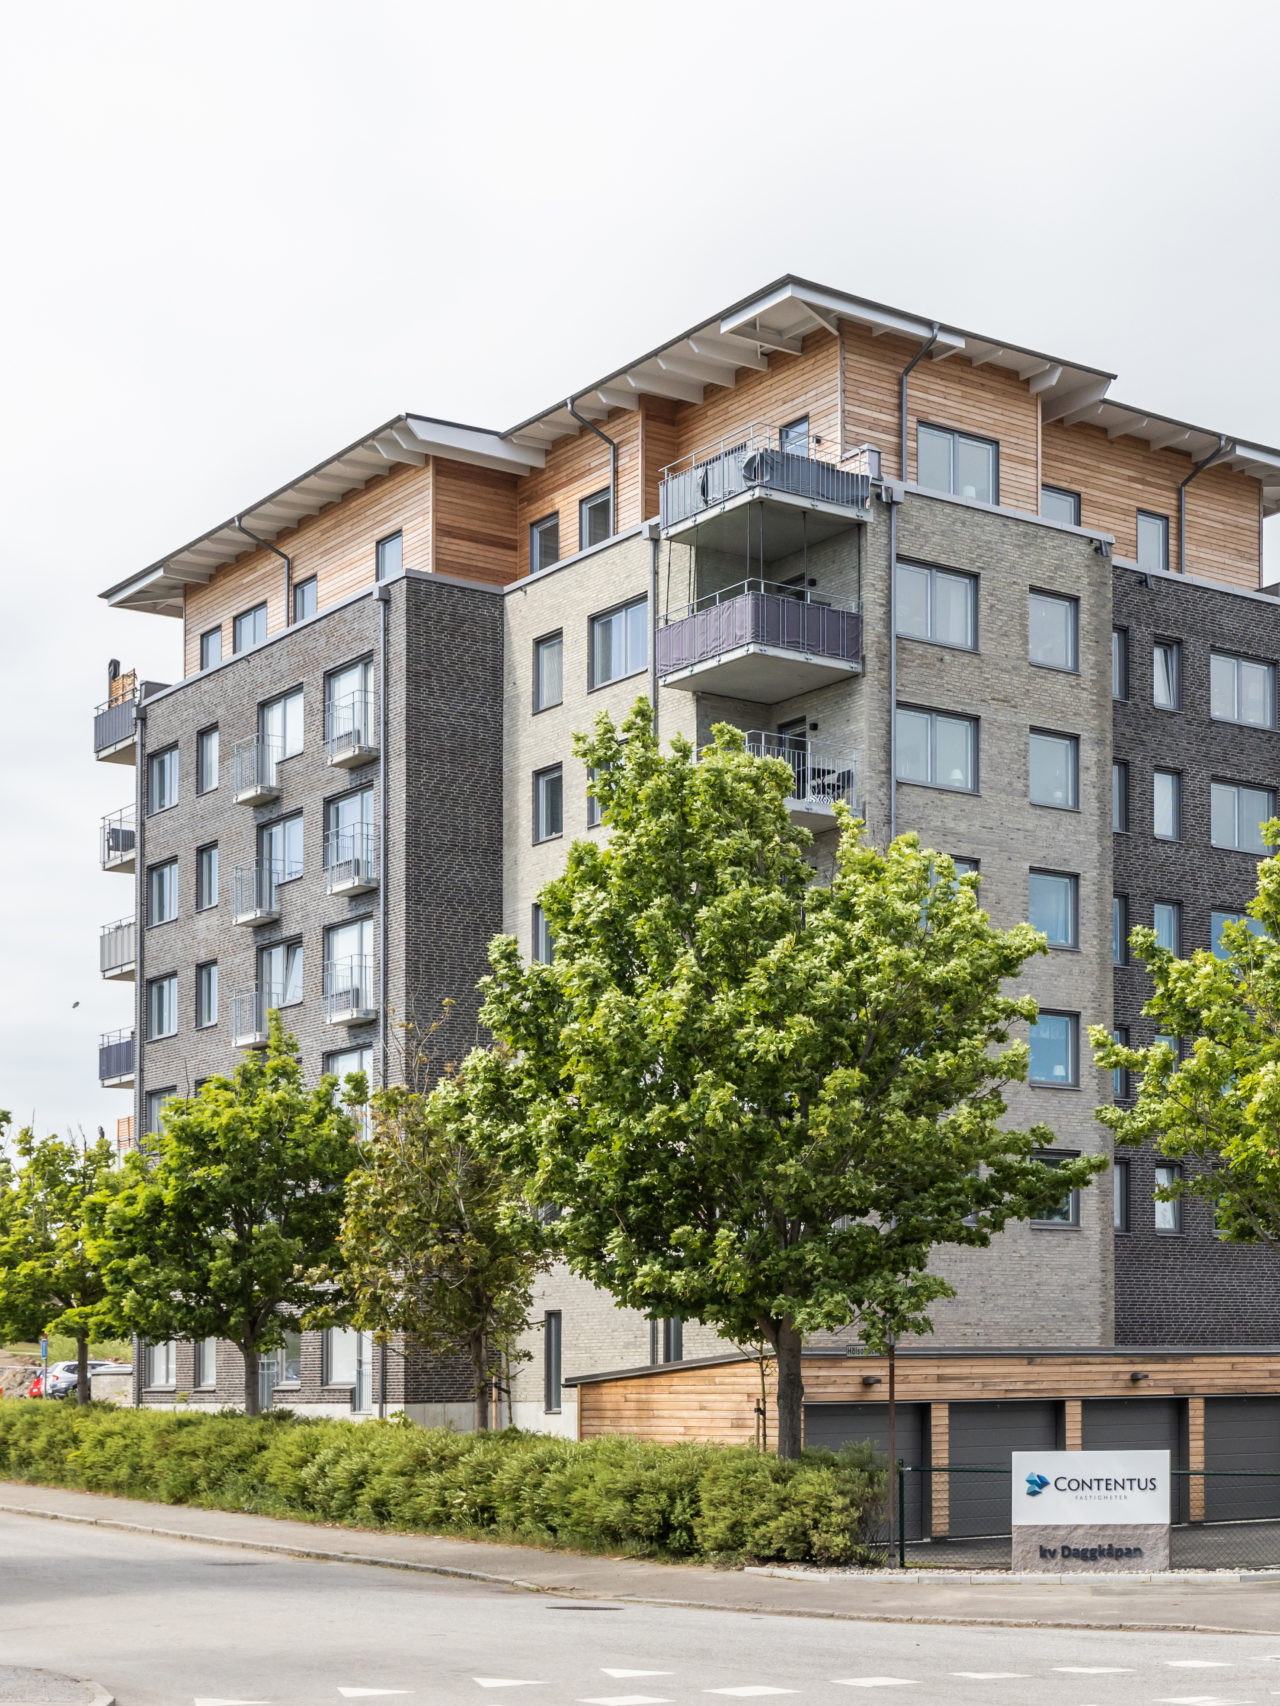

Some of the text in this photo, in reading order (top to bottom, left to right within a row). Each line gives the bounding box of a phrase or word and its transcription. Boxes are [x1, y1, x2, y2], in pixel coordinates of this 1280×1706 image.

[1054, 1476, 1157, 1492] CONTENTUS
[1039, 1543, 1144, 1562] kv Daggkåpan
